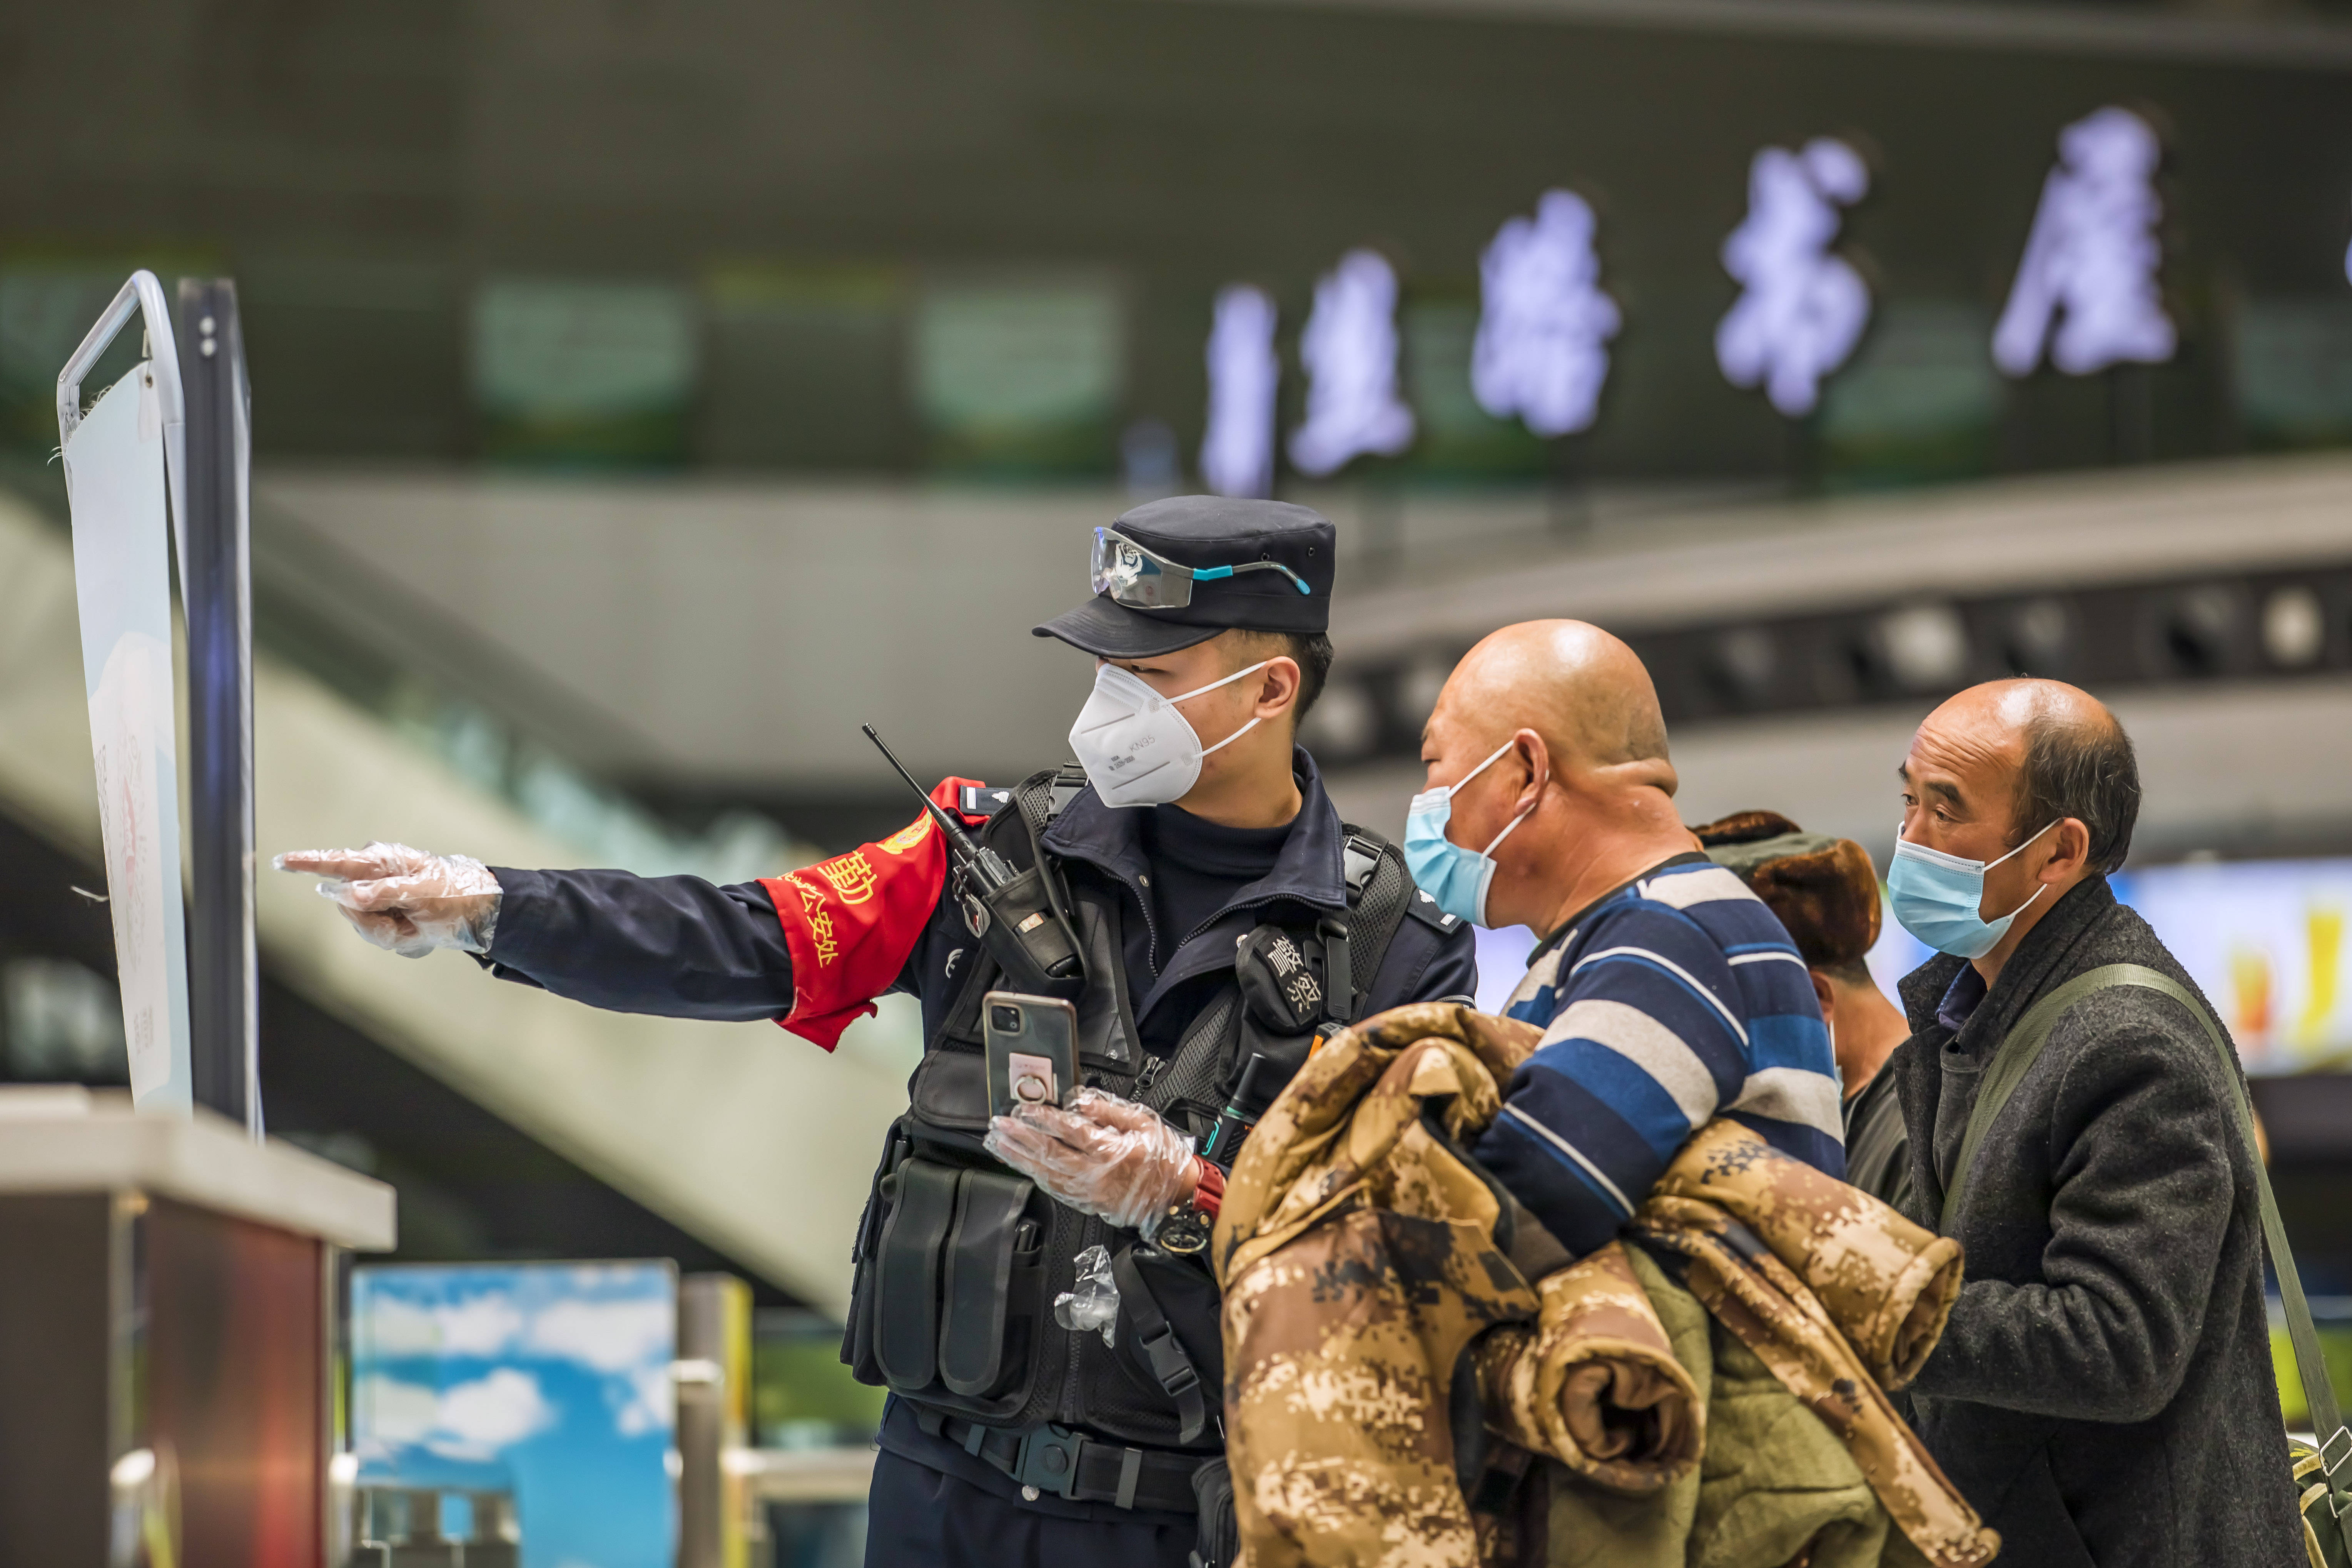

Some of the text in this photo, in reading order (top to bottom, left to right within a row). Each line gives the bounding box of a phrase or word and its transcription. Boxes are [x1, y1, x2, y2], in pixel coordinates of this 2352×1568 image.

[1129, 735, 1156, 753] KN95
[817, 850, 878, 905] 勤
[777, 871, 839, 968] 公安处
[1268, 936, 1321, 1013] 警察
